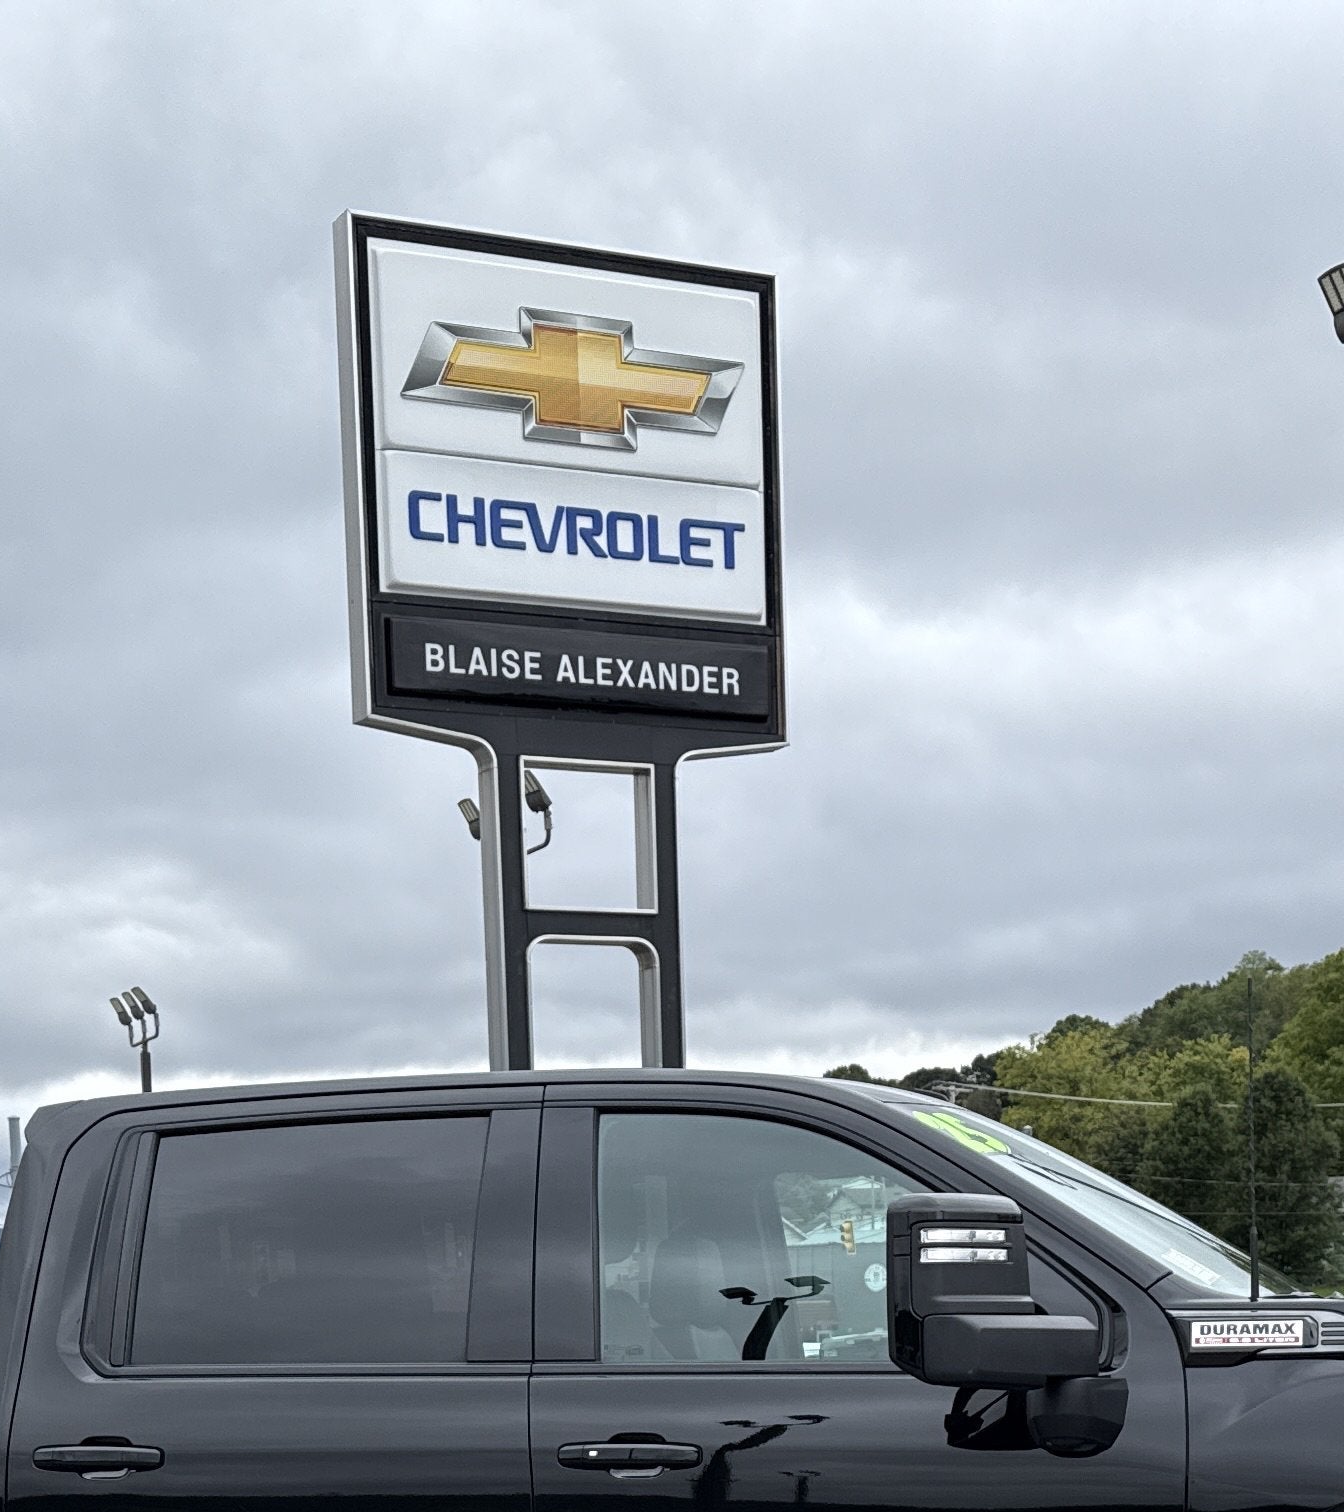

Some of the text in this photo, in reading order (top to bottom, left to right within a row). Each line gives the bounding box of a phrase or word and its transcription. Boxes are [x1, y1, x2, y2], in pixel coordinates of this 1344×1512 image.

[407, 489, 745, 570] CHEVROLET
[424, 642, 740, 696] BLAISE ALEXANDER
[1199, 1323, 1296, 1336] DURAMAX
